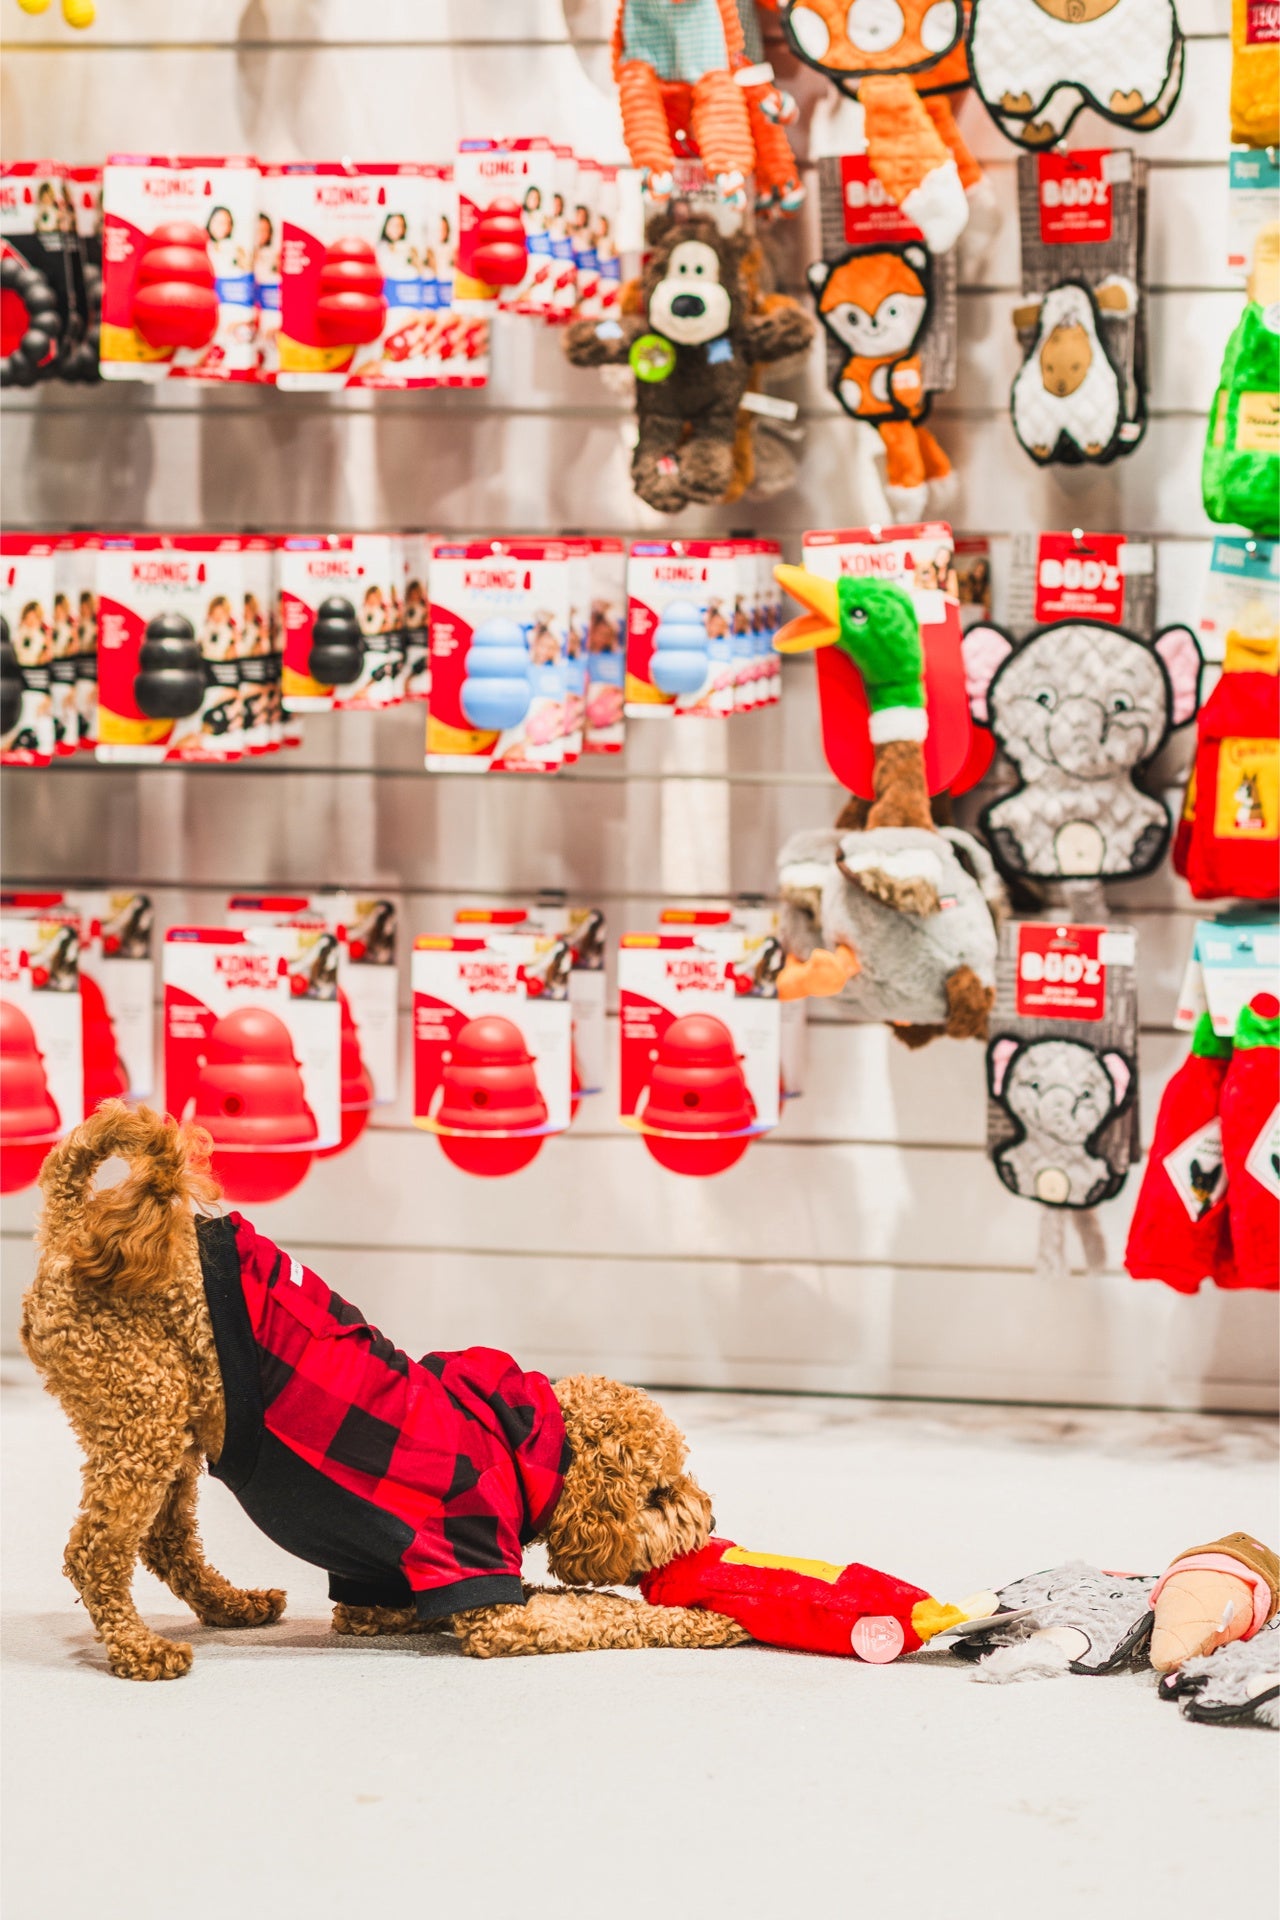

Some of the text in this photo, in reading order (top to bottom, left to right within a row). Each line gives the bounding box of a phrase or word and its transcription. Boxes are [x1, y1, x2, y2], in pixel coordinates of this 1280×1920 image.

[132, 562, 189, 582] KONG
[839, 551, 897, 575] KONG
[215, 955, 269, 974] KONG
[665, 961, 718, 978] KONG
